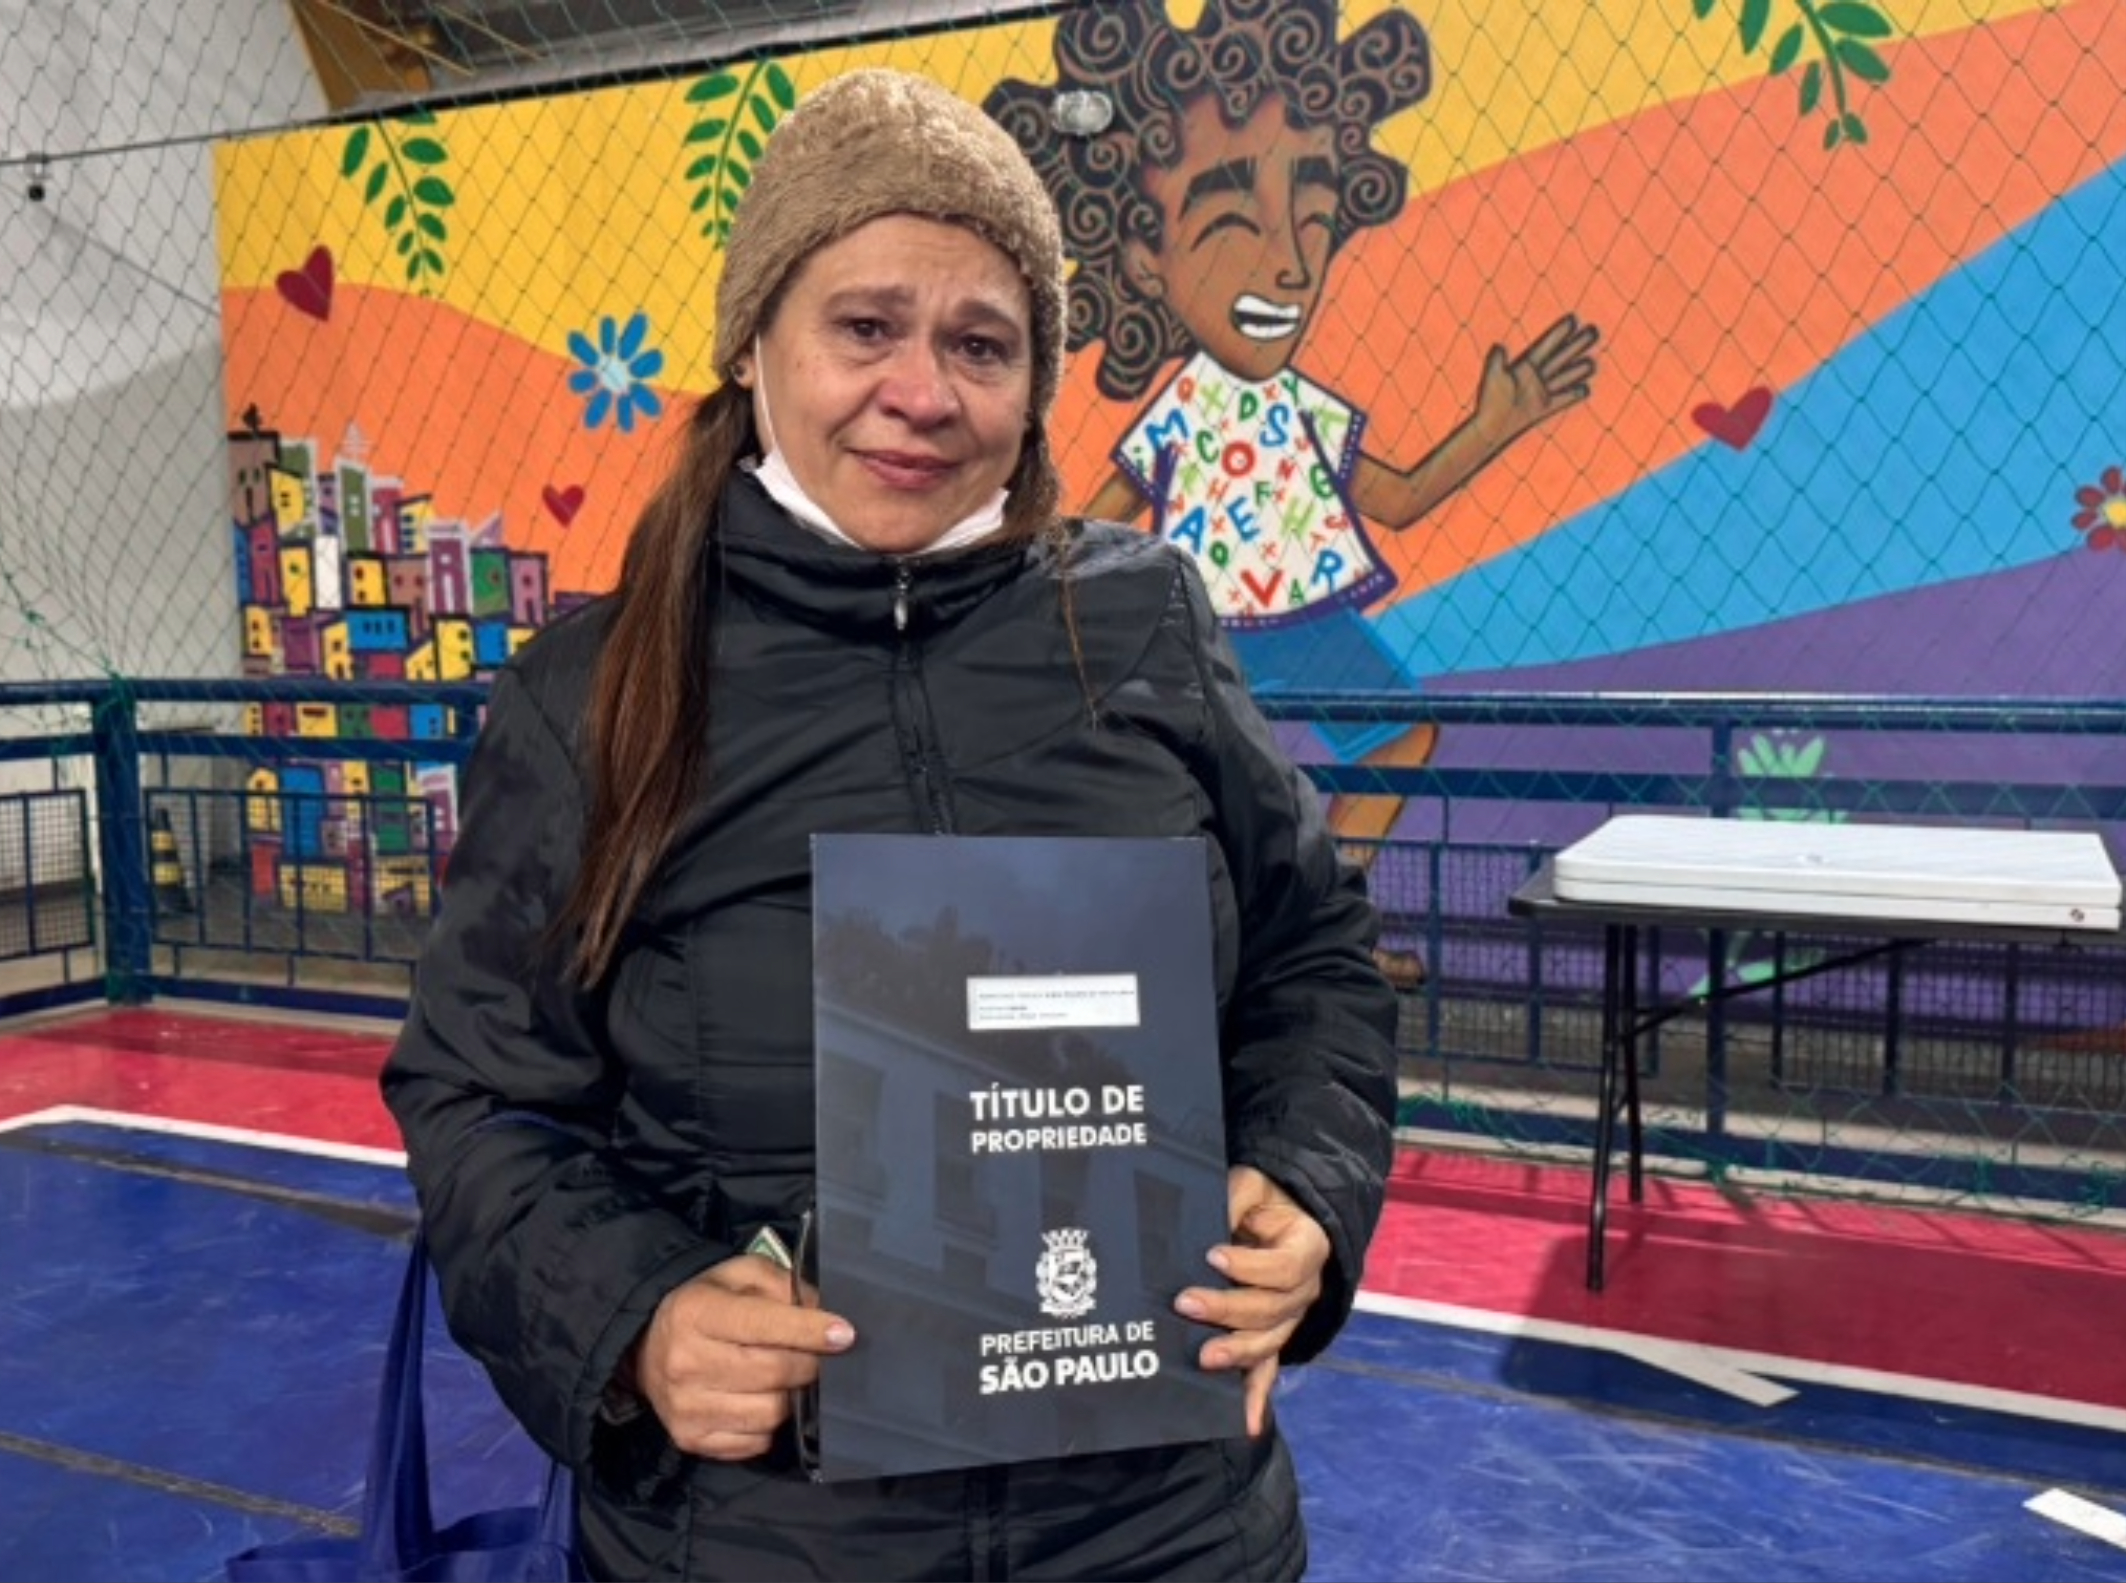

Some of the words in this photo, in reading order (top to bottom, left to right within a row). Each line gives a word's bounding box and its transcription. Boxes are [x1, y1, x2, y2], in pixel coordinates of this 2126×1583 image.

[1238, 390, 1259, 422] D
[1260, 403, 1289, 447] S
[1144, 407, 1189, 451] M
[1196, 429, 1220, 464] C
[1221, 441, 1256, 478] O
[1254, 480, 1272, 507] F
[1169, 503, 1206, 555] A
[1225, 496, 1262, 542] E
[1240, 569, 1284, 608] V
[1310, 548, 1344, 595] R
[1288, 578, 1305, 606] A
[969, 1082, 1091, 1121] TÍTULO
[1101, 1085, 1144, 1115] DE
[971, 1122, 1148, 1154] PROPRIEDADE
[980, 1323, 1119, 1357] PREFEITURA
[1126, 1320, 1155, 1342] DE
[979, 1355, 1049, 1395] SÃO
[1054, 1349, 1160, 1386] PAULO
